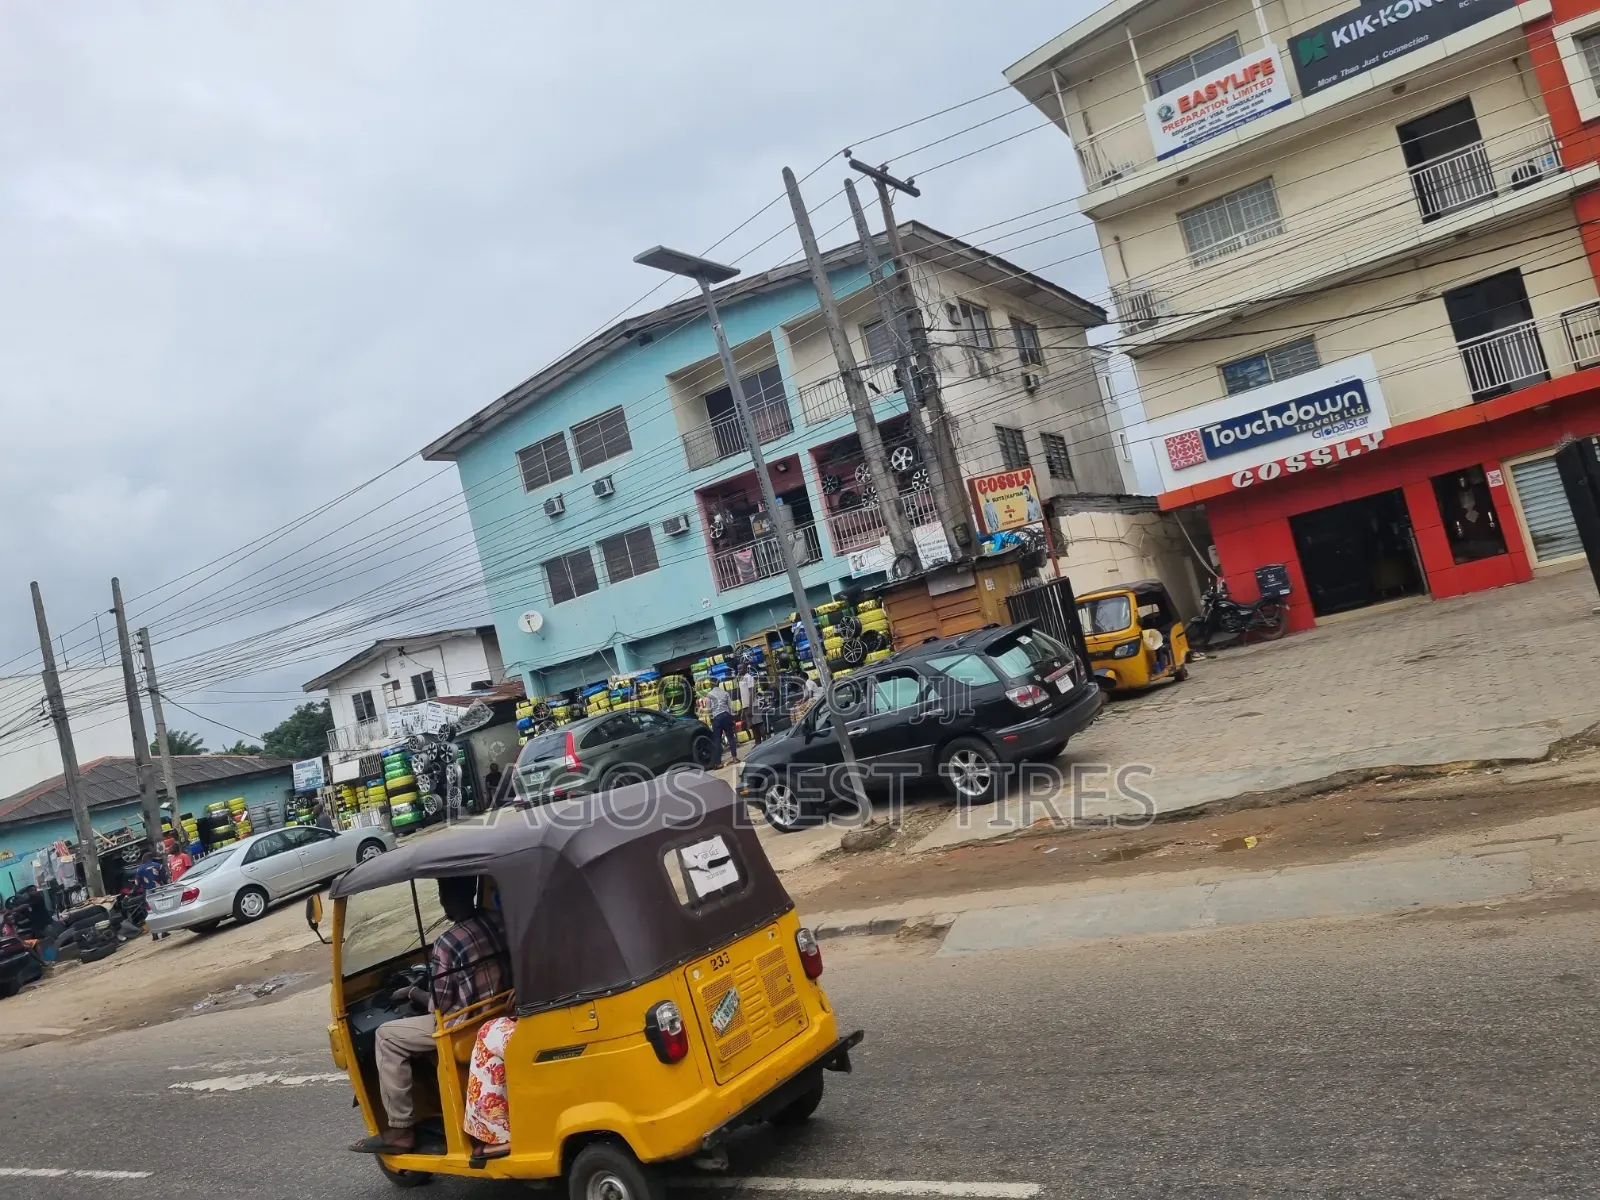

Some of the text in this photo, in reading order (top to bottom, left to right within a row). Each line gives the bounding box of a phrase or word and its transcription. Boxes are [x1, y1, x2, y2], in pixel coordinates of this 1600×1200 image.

[1340, 65, 1359, 76] Than
[1362, 55, 1380, 67] Just
[1382, 34, 1429, 58] Connection
[1162, 97, 1228, 133] PREPARATION
[1233, 78, 1273, 100] LIMITED
[1178, 57, 1275, 113] EASYLIFE
[1227, 88, 1272, 110] CONSULTANTS
[1204, 390, 1362, 448] Touchdown
[1294, 405, 1369, 432] Travels Ltd.
[1312, 416, 1368, 438] GlobalStar
[1232, 430, 1384, 488] COSSLY
[977, 470, 1031, 494] COSSLY
